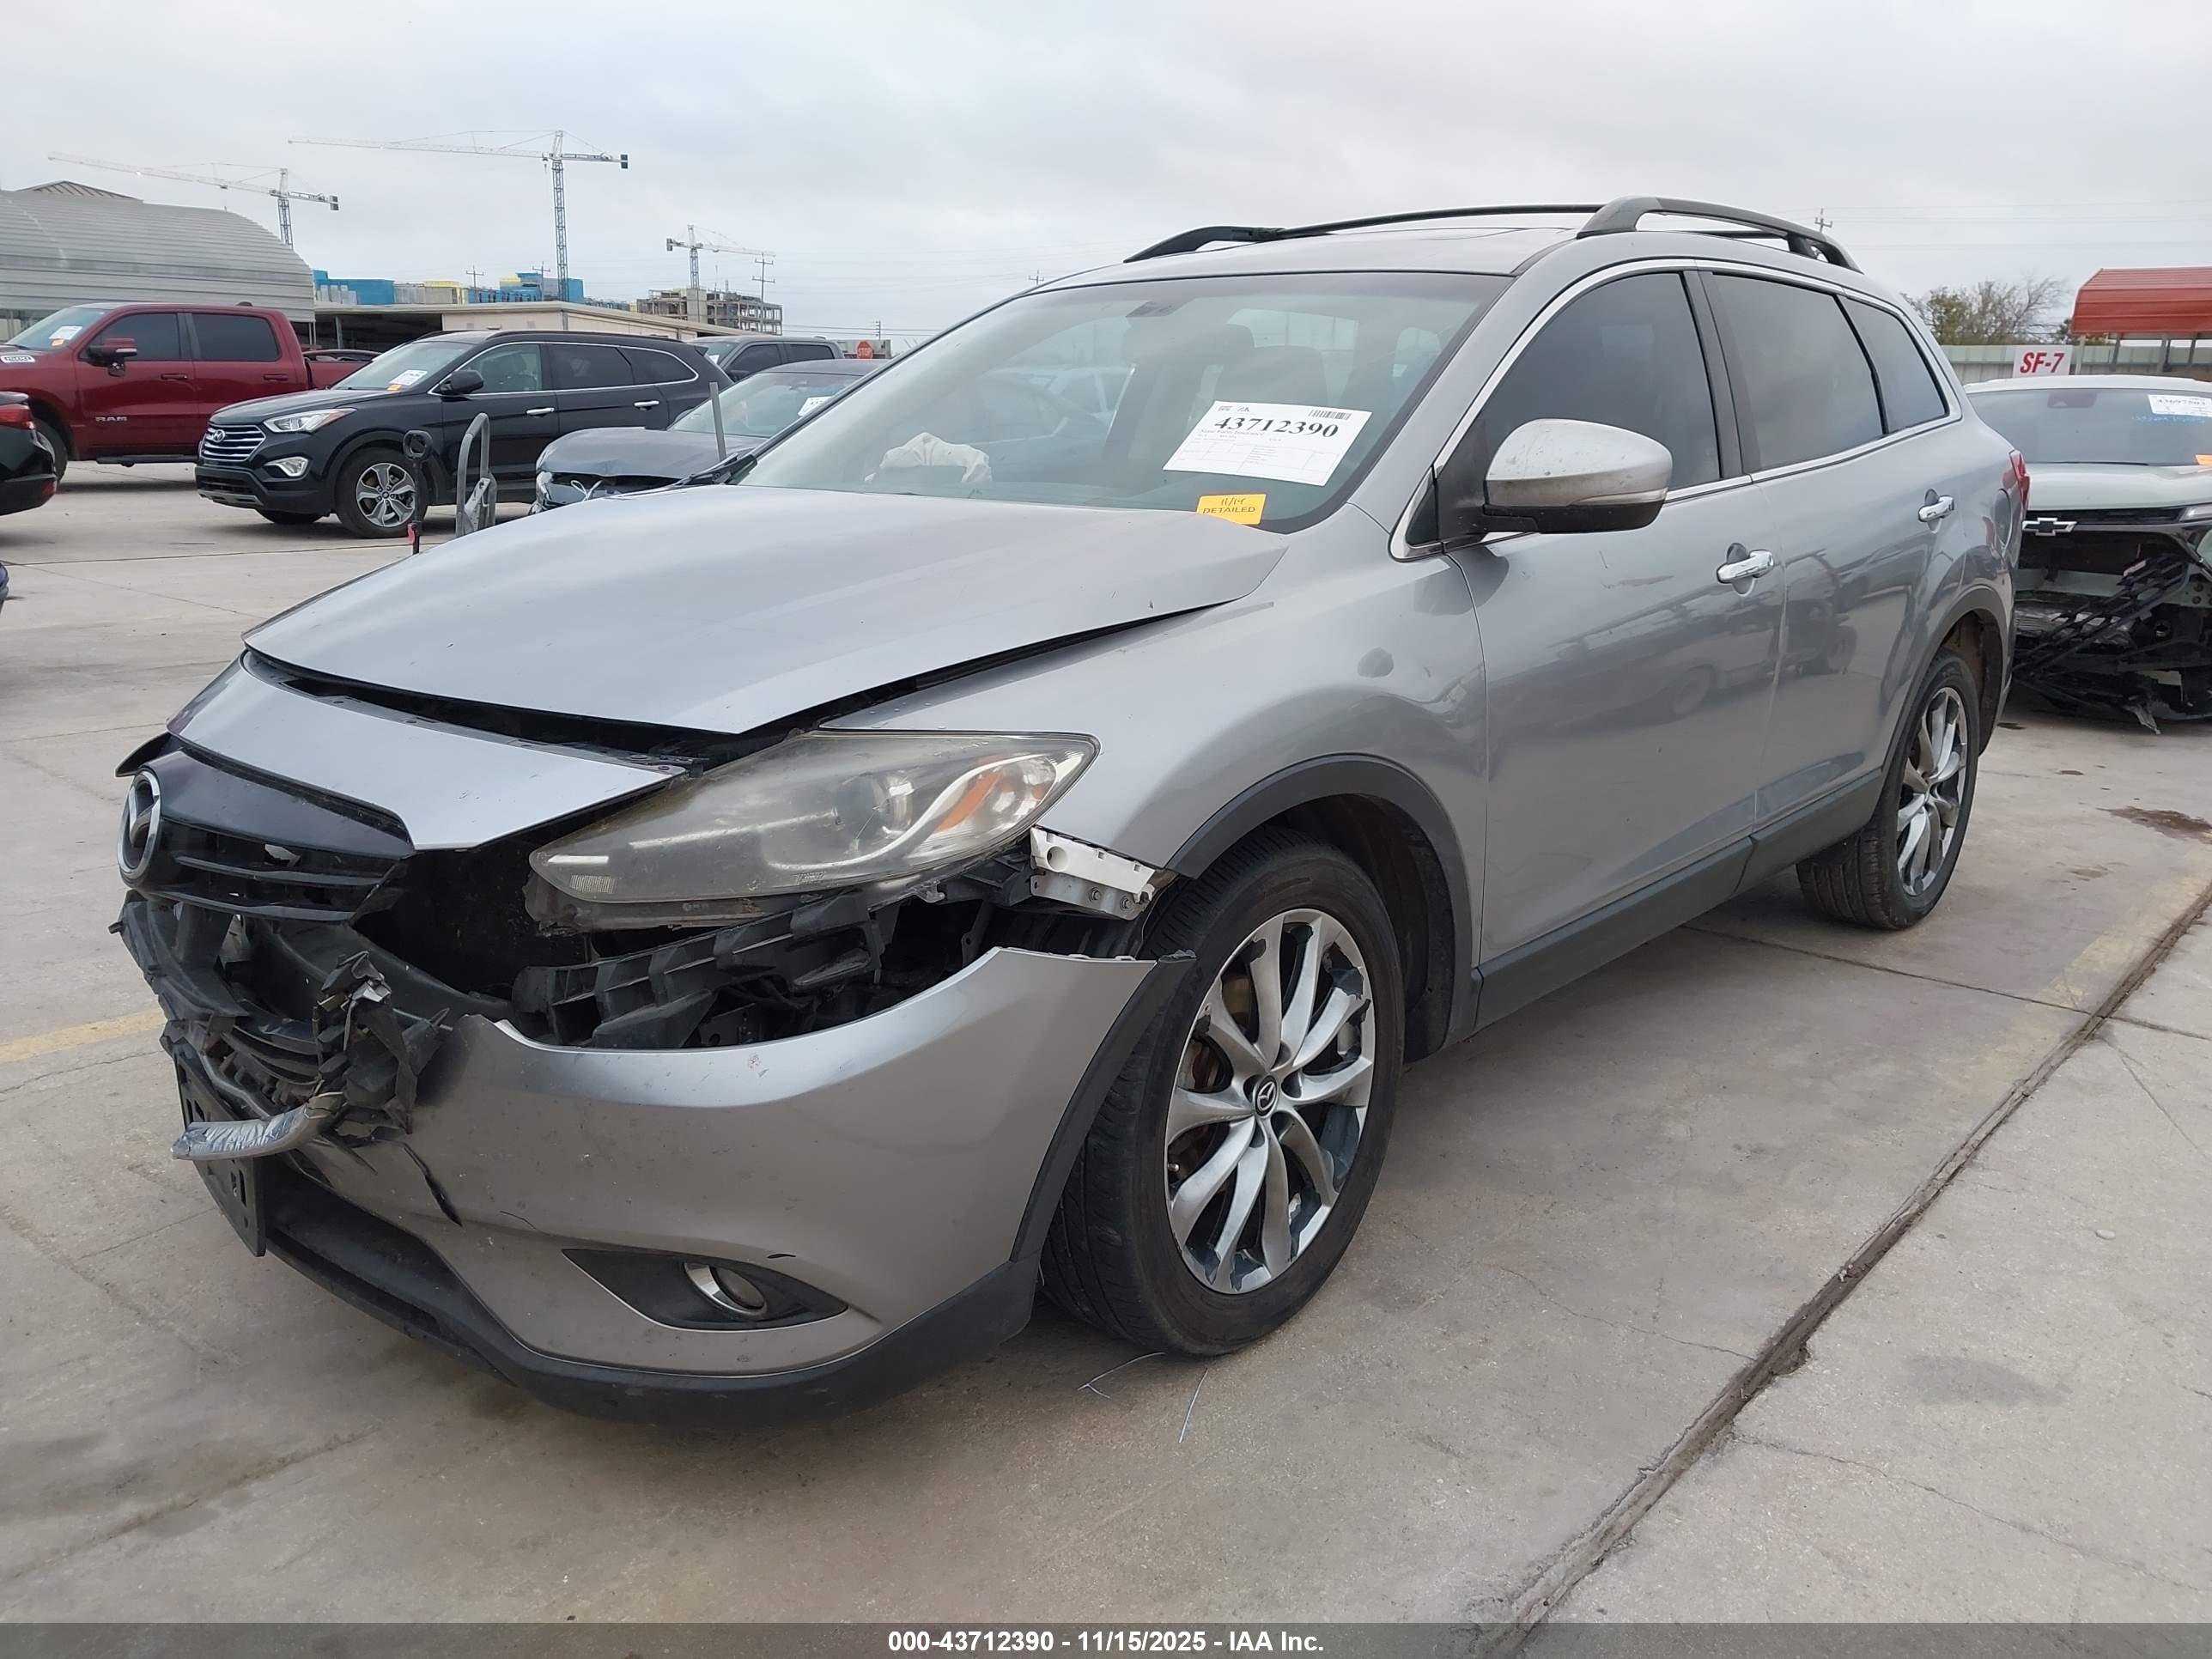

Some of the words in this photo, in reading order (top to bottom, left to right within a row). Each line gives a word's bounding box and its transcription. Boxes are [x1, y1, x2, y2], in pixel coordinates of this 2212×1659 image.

[2020, 352, 2065, 373] SF-7
[1214, 416, 1340, 438] 43712390
[1202, 506, 1256, 514] DETAILED
